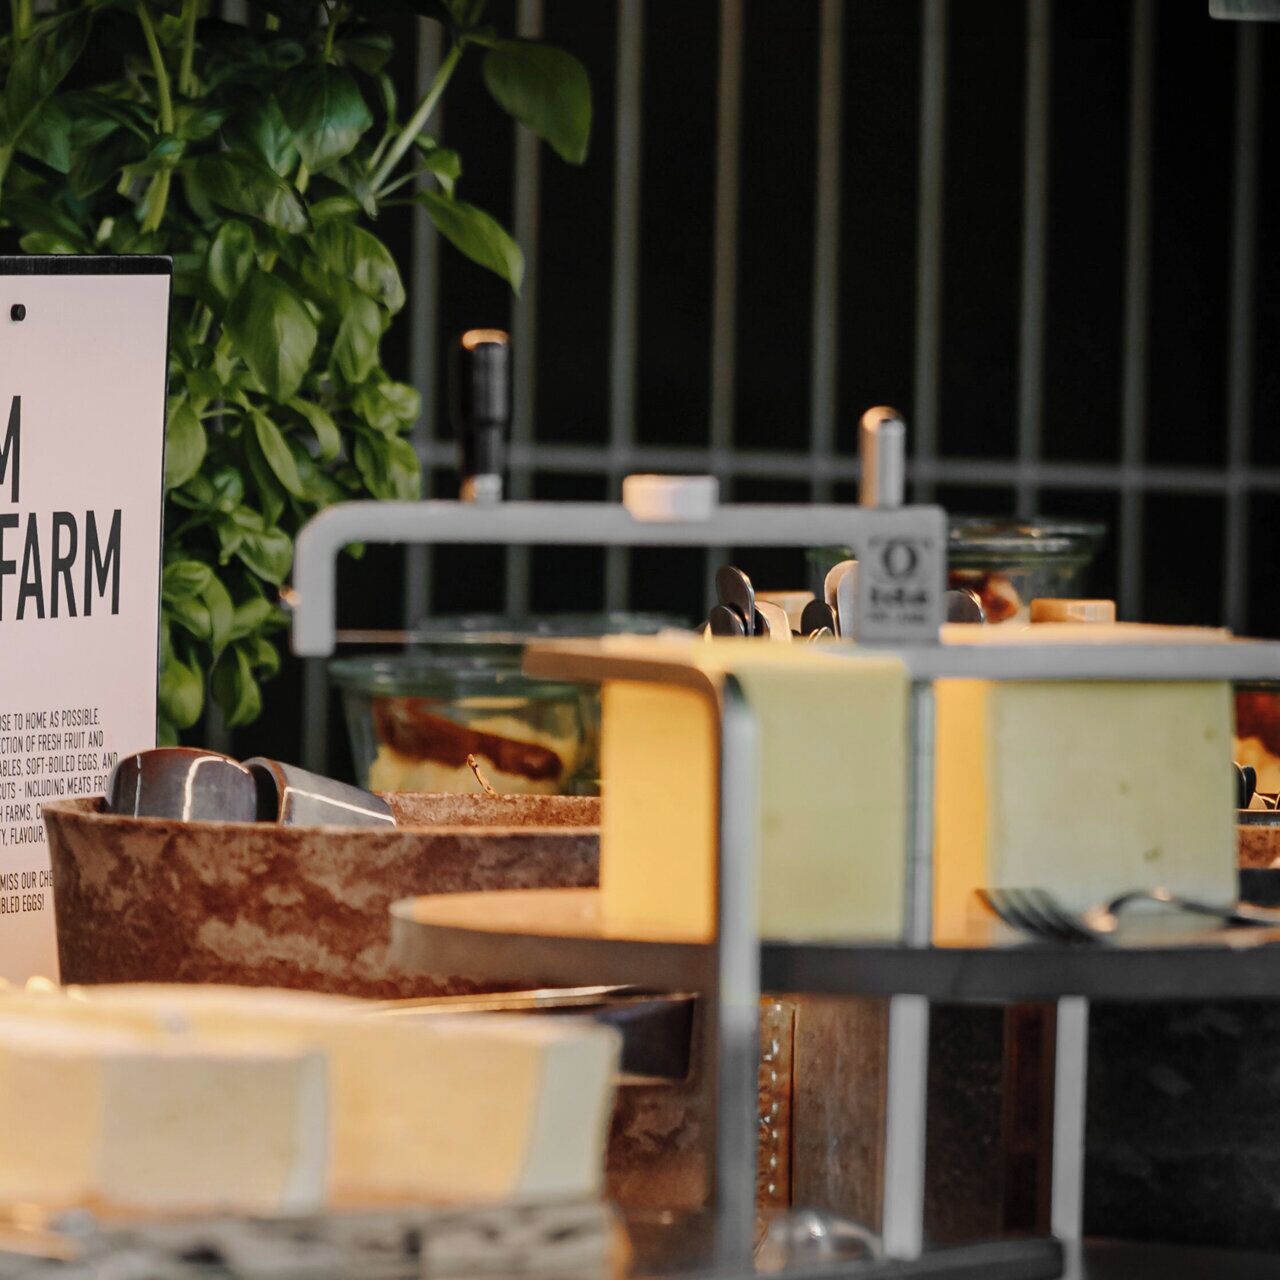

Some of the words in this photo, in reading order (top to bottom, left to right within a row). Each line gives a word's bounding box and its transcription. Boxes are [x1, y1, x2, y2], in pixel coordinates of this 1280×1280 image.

[14, 713, 23, 730] TO
[25, 711, 47, 730] HOME
[49, 710, 59, 728] AS
[61, 708, 100, 727] POSSIBLE.
[25, 735, 35, 752] OF
[37, 732, 62, 751] FRESH
[64, 731, 85, 750] FRUIT
[87, 730, 104, 748] AND
[26, 754, 75, 775] SOFT-BOILED
[77, 753, 99, 771] EGGS,
[102, 751, 118, 769] AND
[24, 778, 65, 798] INCLUDING
[67, 776, 91, 795] MEATS
[10, 825, 46, 844] FLAVOUR,
[0, 873, 19, 891] MISS
[21, 871, 37, 889] OUR
[22, 893, 45, 912] EGGS!
